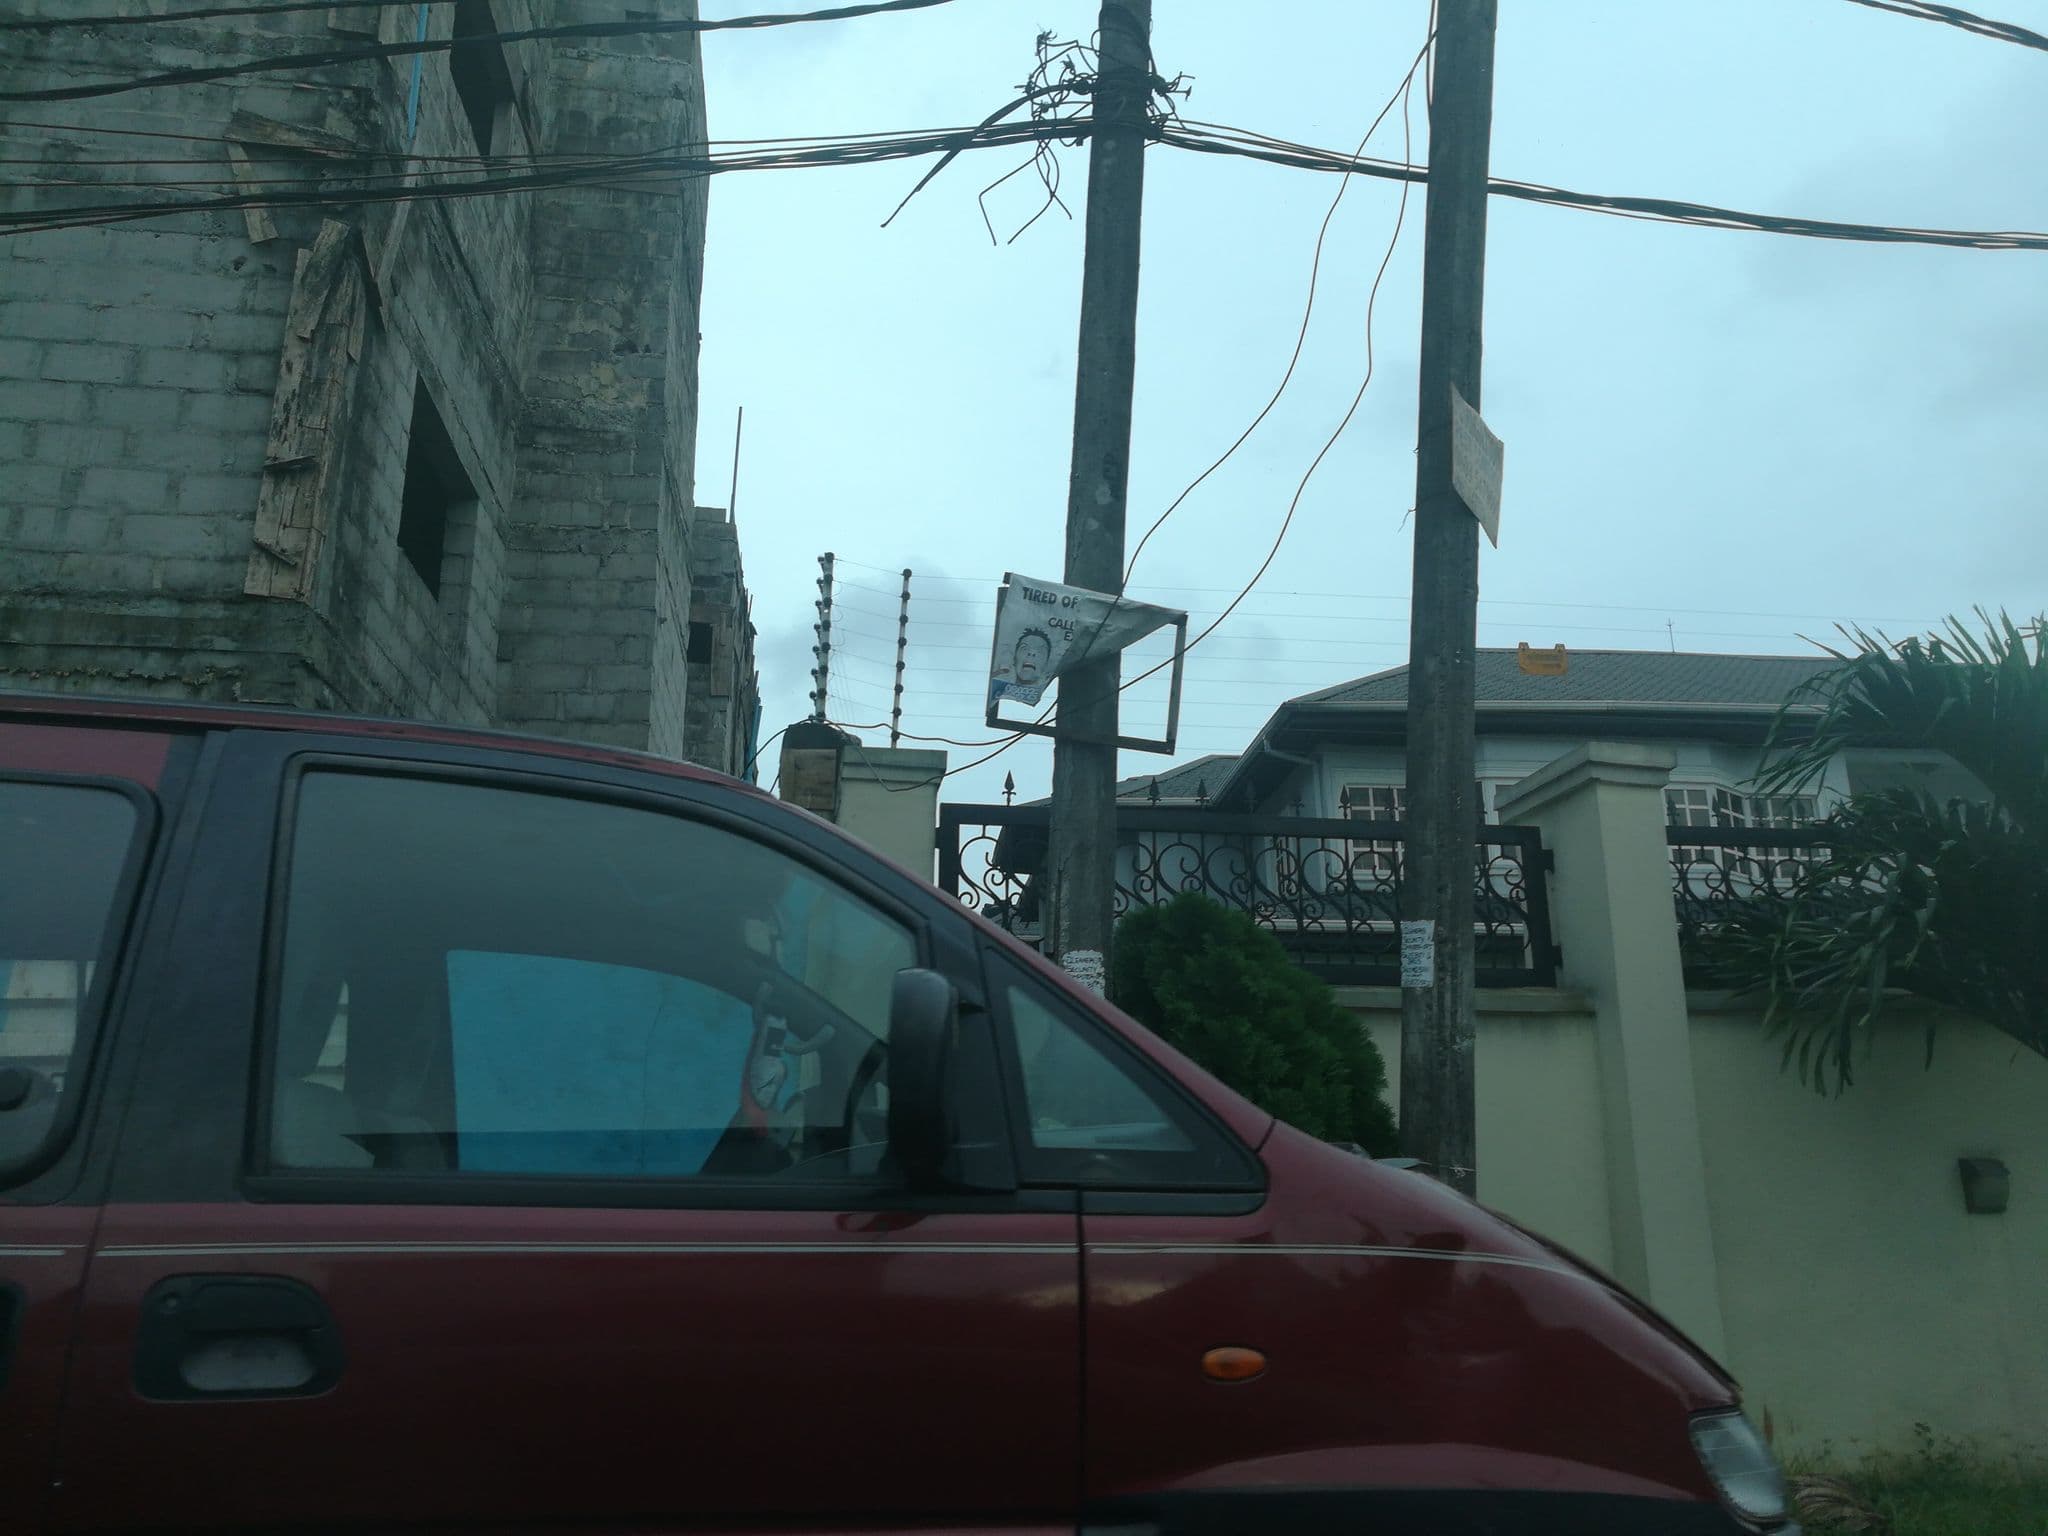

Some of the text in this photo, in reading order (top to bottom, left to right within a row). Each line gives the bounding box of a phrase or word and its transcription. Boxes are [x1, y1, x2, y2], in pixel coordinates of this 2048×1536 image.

[1022, 586, 1079, 609] TIRED OF
[1048, 617, 1074, 632] CALL
